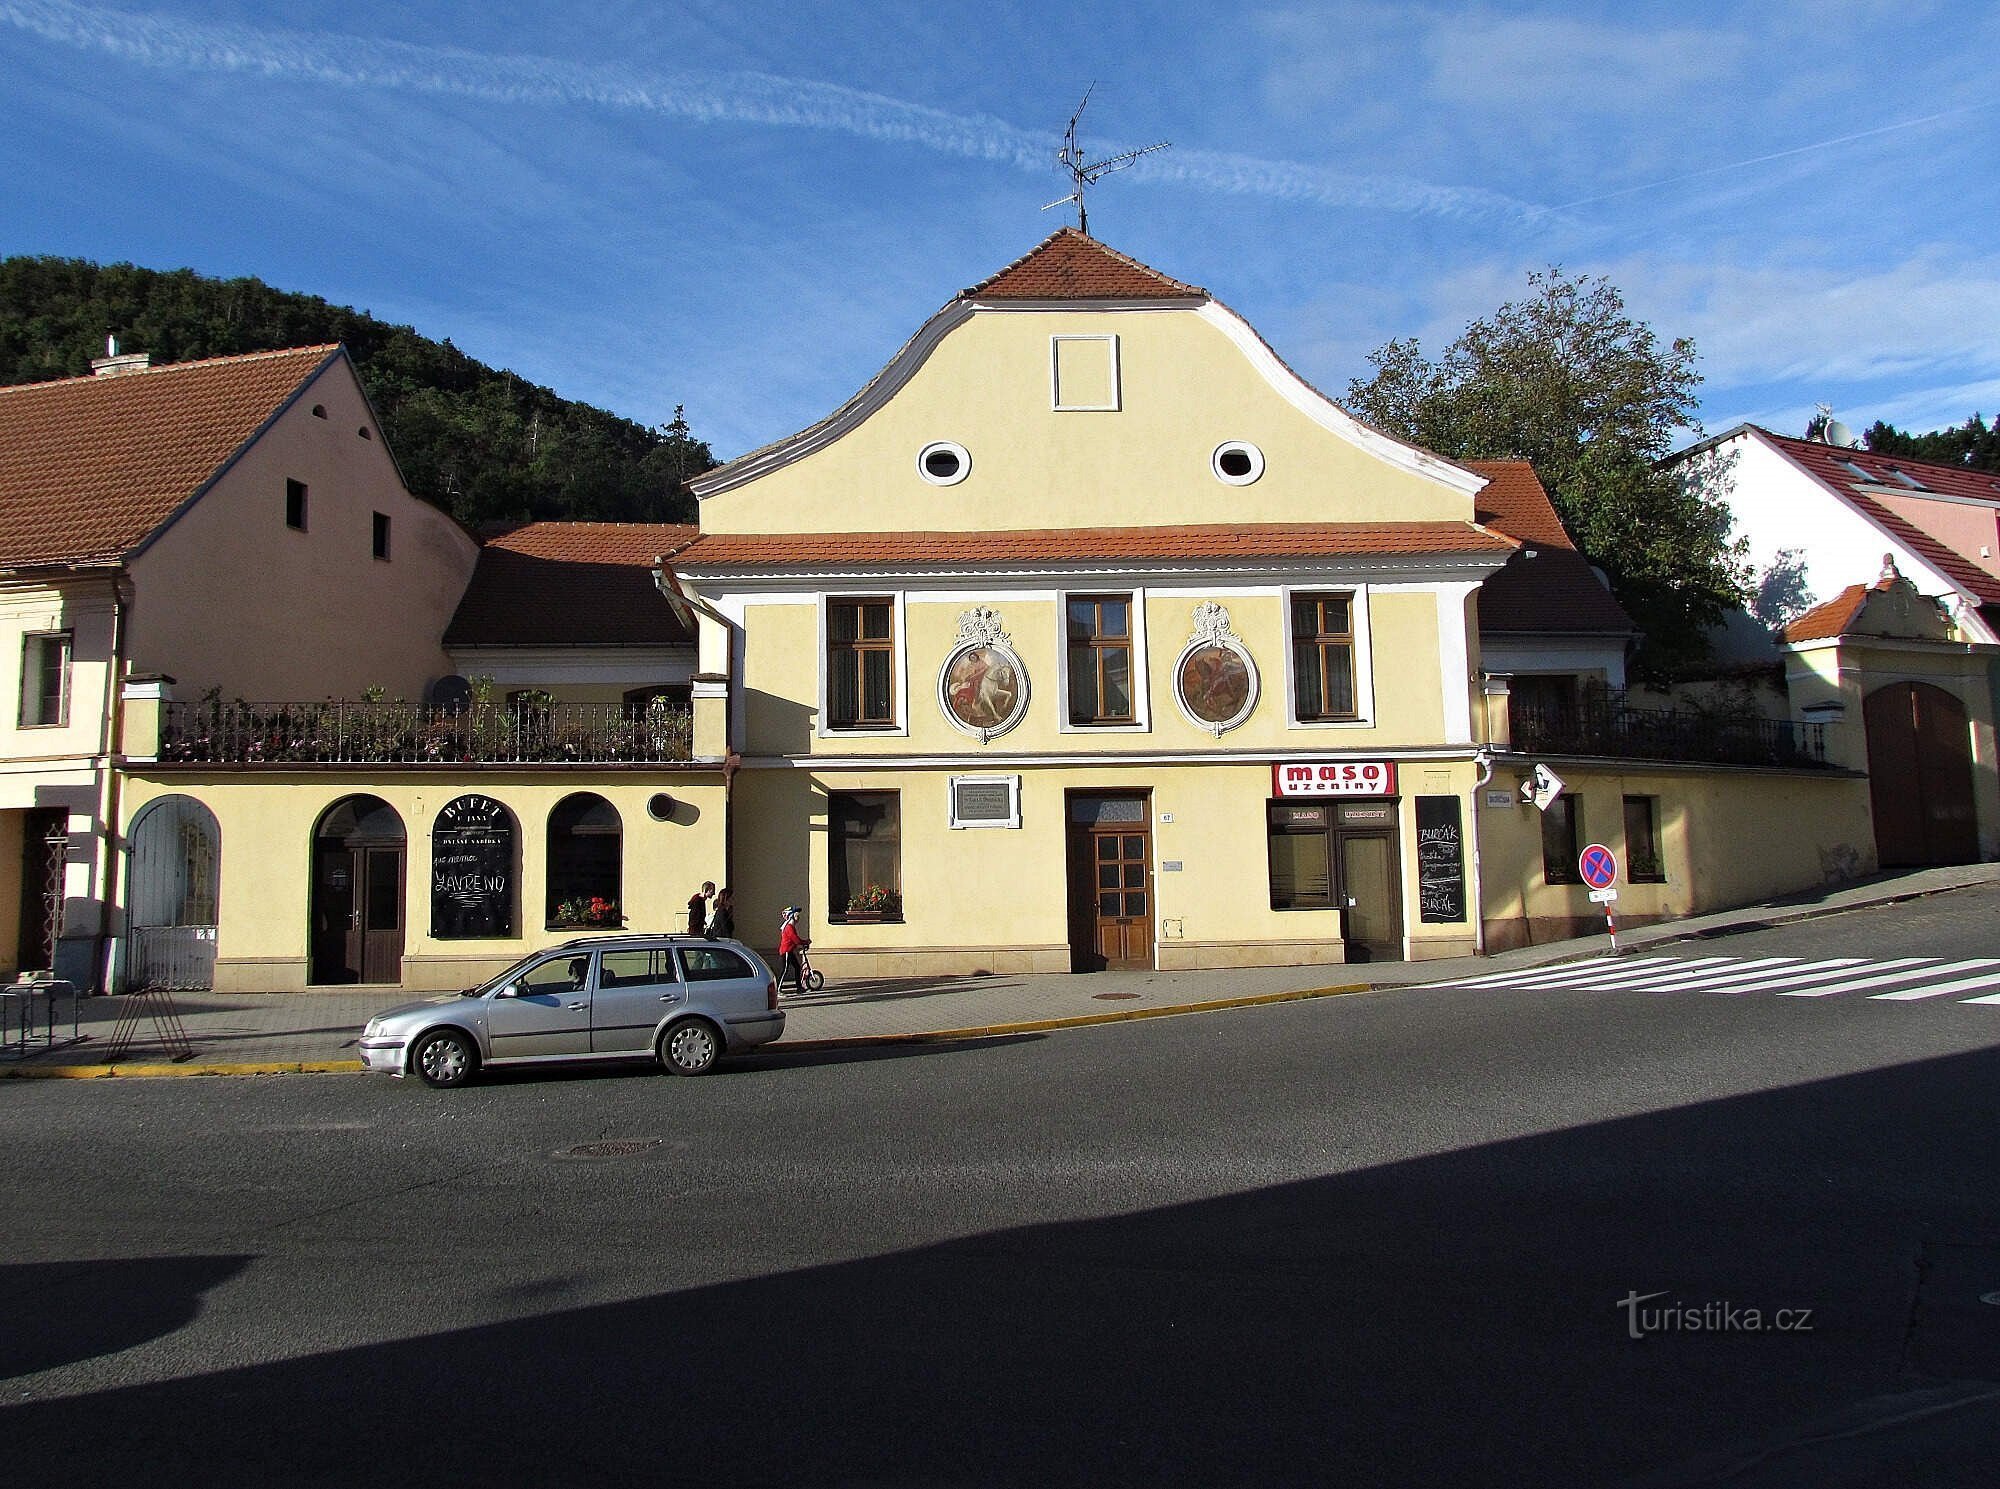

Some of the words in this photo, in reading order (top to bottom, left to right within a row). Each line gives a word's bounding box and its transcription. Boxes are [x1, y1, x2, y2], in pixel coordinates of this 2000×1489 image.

[1287, 766, 1380, 781] maso
[1288, 782, 1378, 791] uzeniny
[444, 798, 502, 818] BUFET
